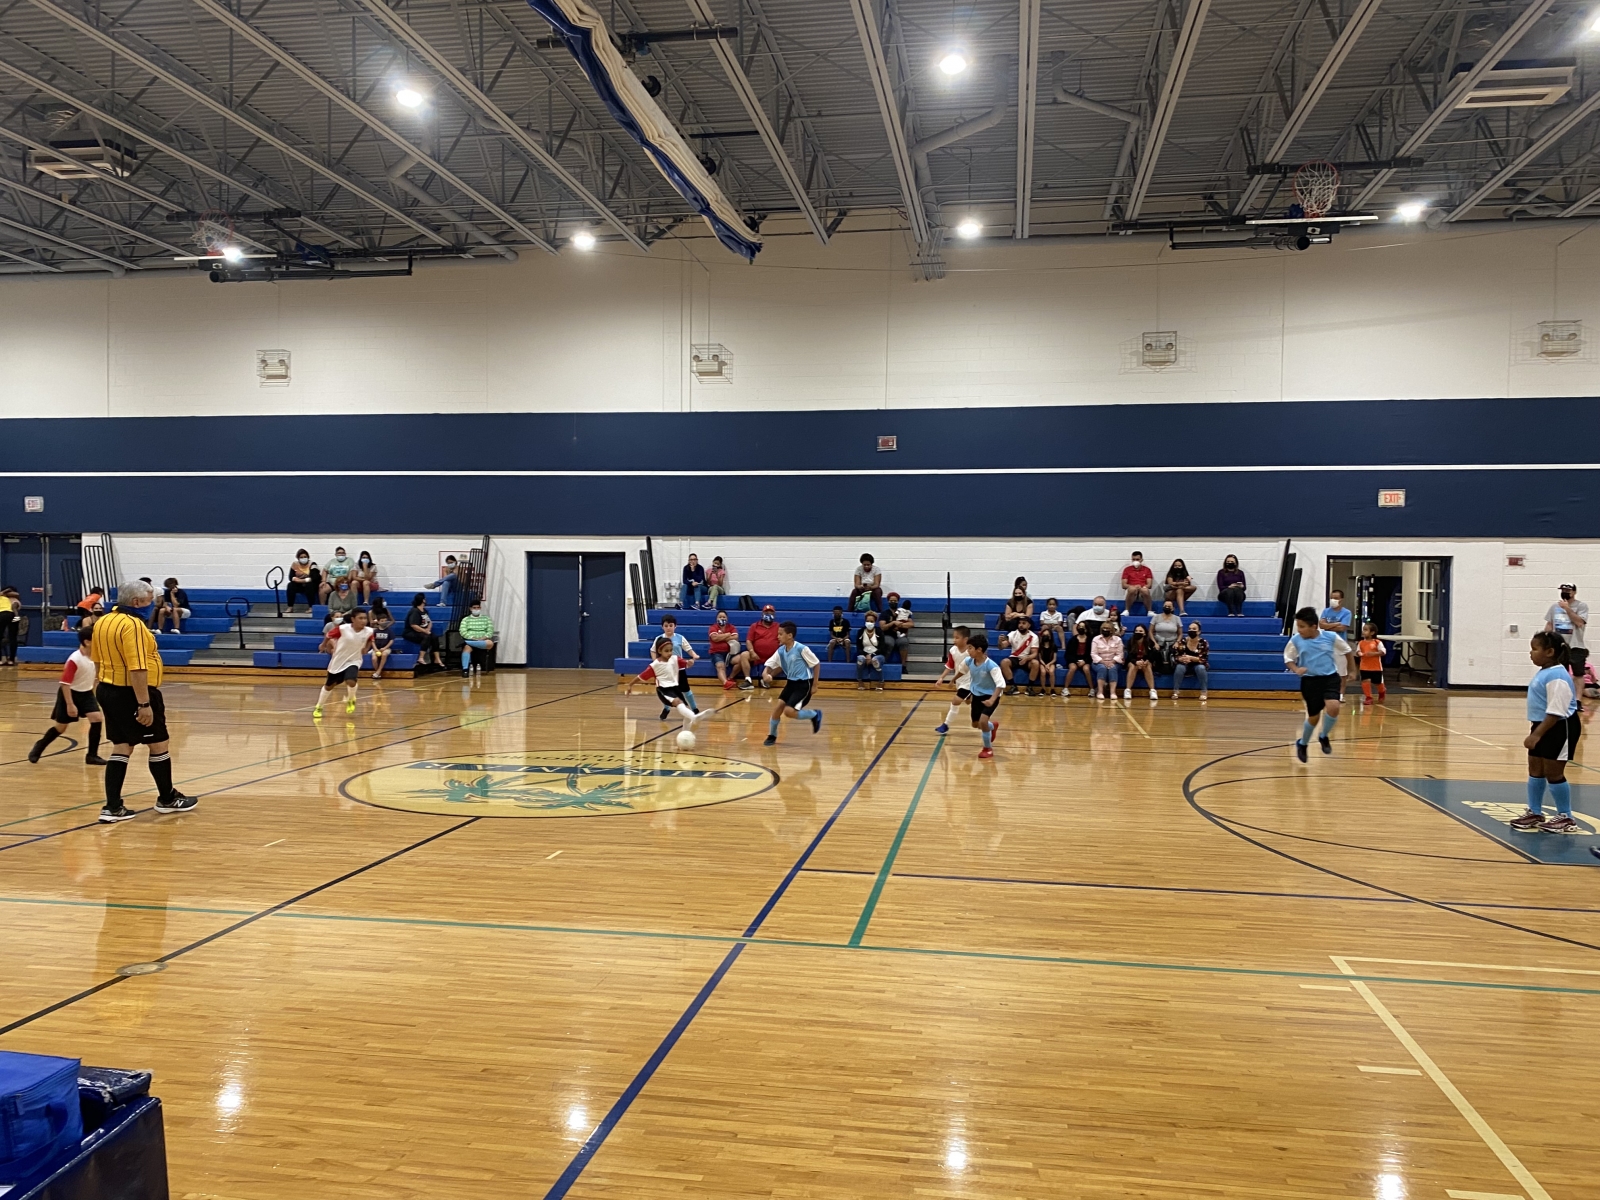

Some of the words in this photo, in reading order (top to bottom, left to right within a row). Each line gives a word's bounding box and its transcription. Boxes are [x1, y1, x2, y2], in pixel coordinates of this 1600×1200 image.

[1384, 493, 1399, 504] EXIT
[423, 763, 746, 778] MIRAMAR
[173, 799, 184, 808] N
